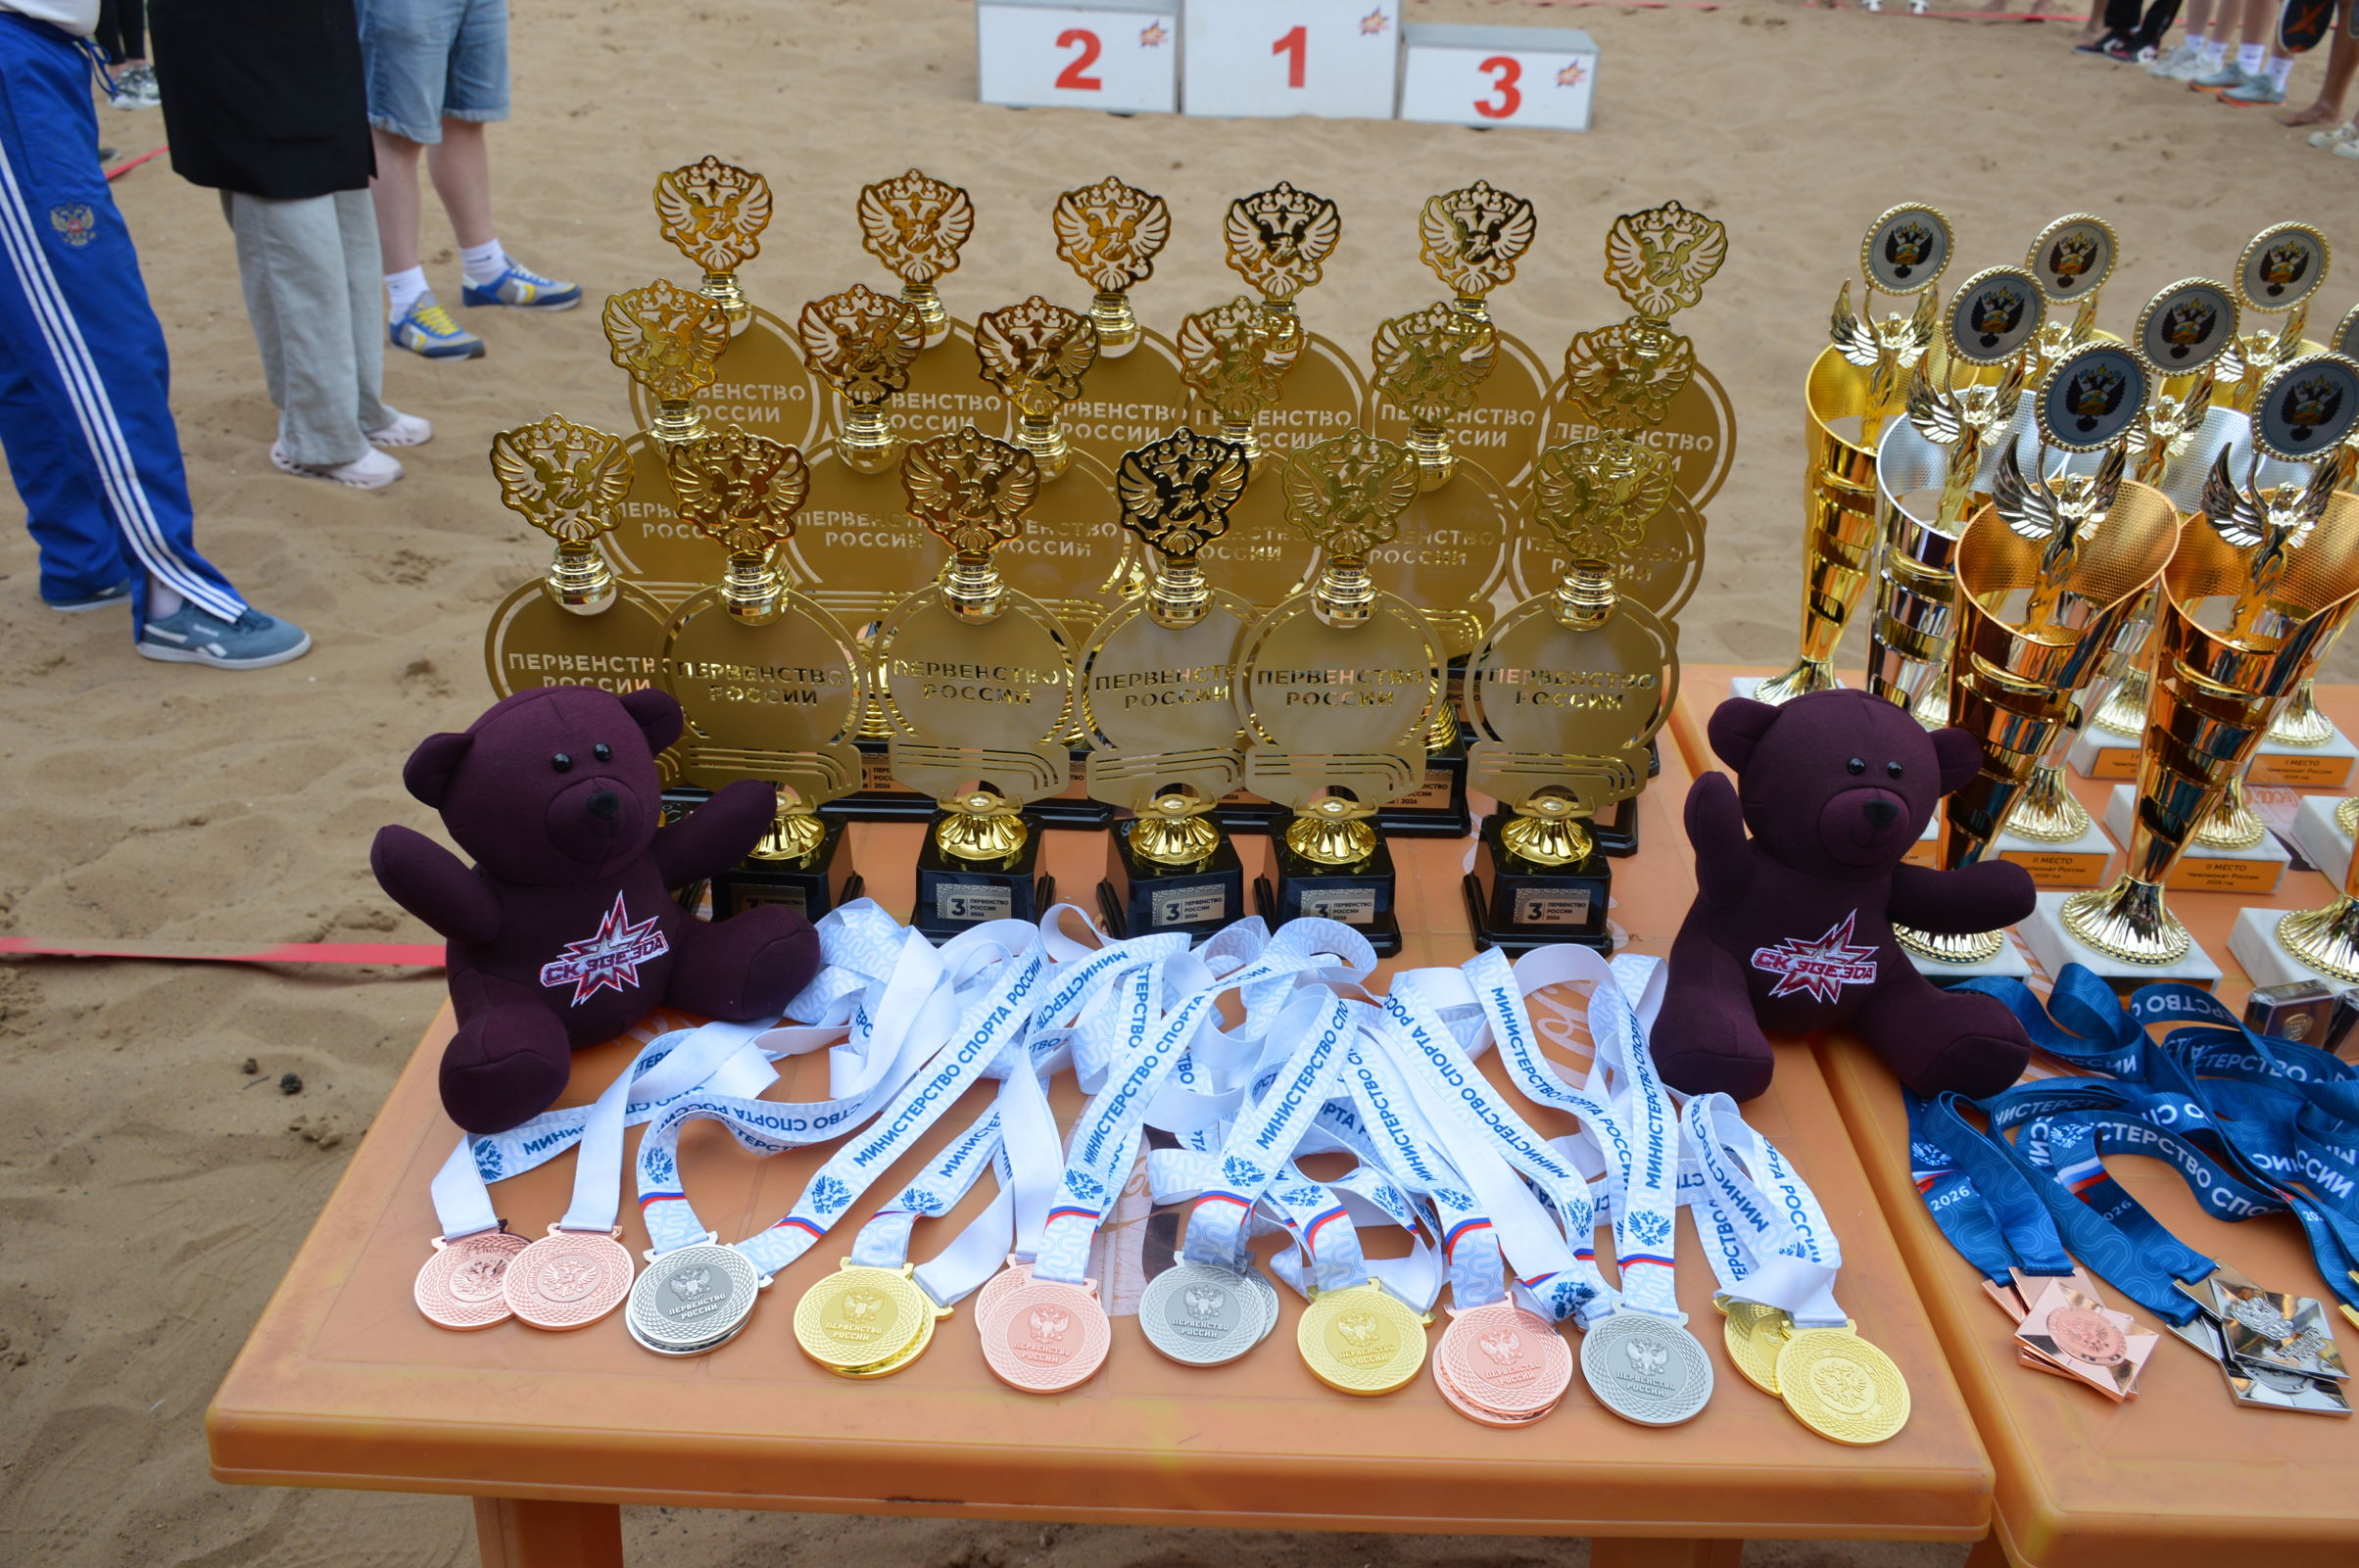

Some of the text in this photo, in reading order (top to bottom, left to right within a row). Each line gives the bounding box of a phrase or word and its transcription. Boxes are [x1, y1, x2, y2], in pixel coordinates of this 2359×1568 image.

[1054, 28, 1102, 91] 2
[1272, 26, 1307, 88] 1
[1473, 56, 1522, 119] 3
[697, 383, 805, 402] ВЕНСТВО
[891, 392, 1001, 411] ВЕНСТВО
[697, 404, 780, 422] ОССИИ
[890, 413, 975, 431] ОССИИ
[1054, 402, 1188, 421] РВЕНСТВО
[1196, 408, 1352, 427] ПЕЕНСТВО
[1060, 422, 1160, 442] РОССИИ
[1259, 432, 1324, 448] ССИИ
[1554, 422, 1713, 451] ПЕРНСТВО
[643, 523, 705, 539] РОСС
[825, 532, 923, 548] РОССИИ
[1199, 545, 1281, 561] ОССИИ
[676, 661, 845, 687] ПЕРВЕНСТВО
[892, 659, 1060, 685] ПЕРВЕНСТВО
[1095, 663, 1237, 691] ПЕРВЕНСТВ
[1257, 668, 1425, 686] ПЕРВЕНСТВО
[1488, 668, 1657, 689] ПЕРВЕНСТВО
[709, 685, 818, 706] РОССИИ
[924, 684, 1032, 706] РОССИИ
[1126, 686, 1228, 710] РОССИИ
[1286, 691, 1394, 707] РОССИИ
[1516, 691, 1624, 710] РОССИИ
[951, 898, 966, 916] 3
[1166, 903, 1180, 921] 3
[1184, 897, 1223, 906] ПЕРВЕНСТВО
[1316, 904, 1328, 918] 3
[1528, 903, 1543, 920] 3
[546, 936, 664, 980] СК ЗВЕЗДА
[1755, 952, 1873, 979] СК ЗВЕЗДА
[1129, 967, 1151, 1049] ТЕРСТВО
[1384, 993, 1415, 1026] РОСС
[852, 956, 1043, 1167] МИНИСТЕРСТВО СПОРТА РОССИИ
[1411, 1023, 1464, 1087] СПОРТА
[1083, 1056, 1160, 1167] МИНИСТЕРСТВО
[1156, 994, 1206, 1054] СПОРТА
[1256, 1028, 1336, 1152] МИНИСТЕРСТВО
[1331, 1000, 1350, 1031] СПО
[1491, 987, 1561, 1100] МИНИСТЕРСТВО
[1559, 1094, 1604, 1117] СПОРТА
[1600, 1117, 1632, 1191] РОССИ
[1630, 1014, 1663, 1190] МИНИСТЕРСТВО СПОРТА
[734, 1106, 808, 1132] СПОРТА
[1324, 1103, 1356, 1129] РТА
[1357, 1068, 1438, 1183] МИНИСТЕРСТВО
[1461, 1087, 1570, 1181] МИНИСТЕРСТВО
[1763, 1136, 1786, 1180] ОРТА
[2097, 1120, 2269, 1217] СТЕРСТВО СПО
[2296, 1149, 2355, 1200] ССИИ
[1930, 1185, 1970, 1211] 2026
[669, 1293, 726, 1315] ПЕРВЕНСТВО
[681, 1304, 718, 1320] РОССИИ
[826, 1323, 882, 1334] ПЕРВЕНСТВО
[1173, 1318, 1228, 1331] ПЕРВЕНСТВО
[1181, 1328, 1218, 1338] РОССИИ
[833, 1332, 870, 1341] РОССИИ
[1616, 1371, 1676, 1390] ПЕРВЕНСТВО
[1626, 1382, 1664, 1398] РОССИИ
